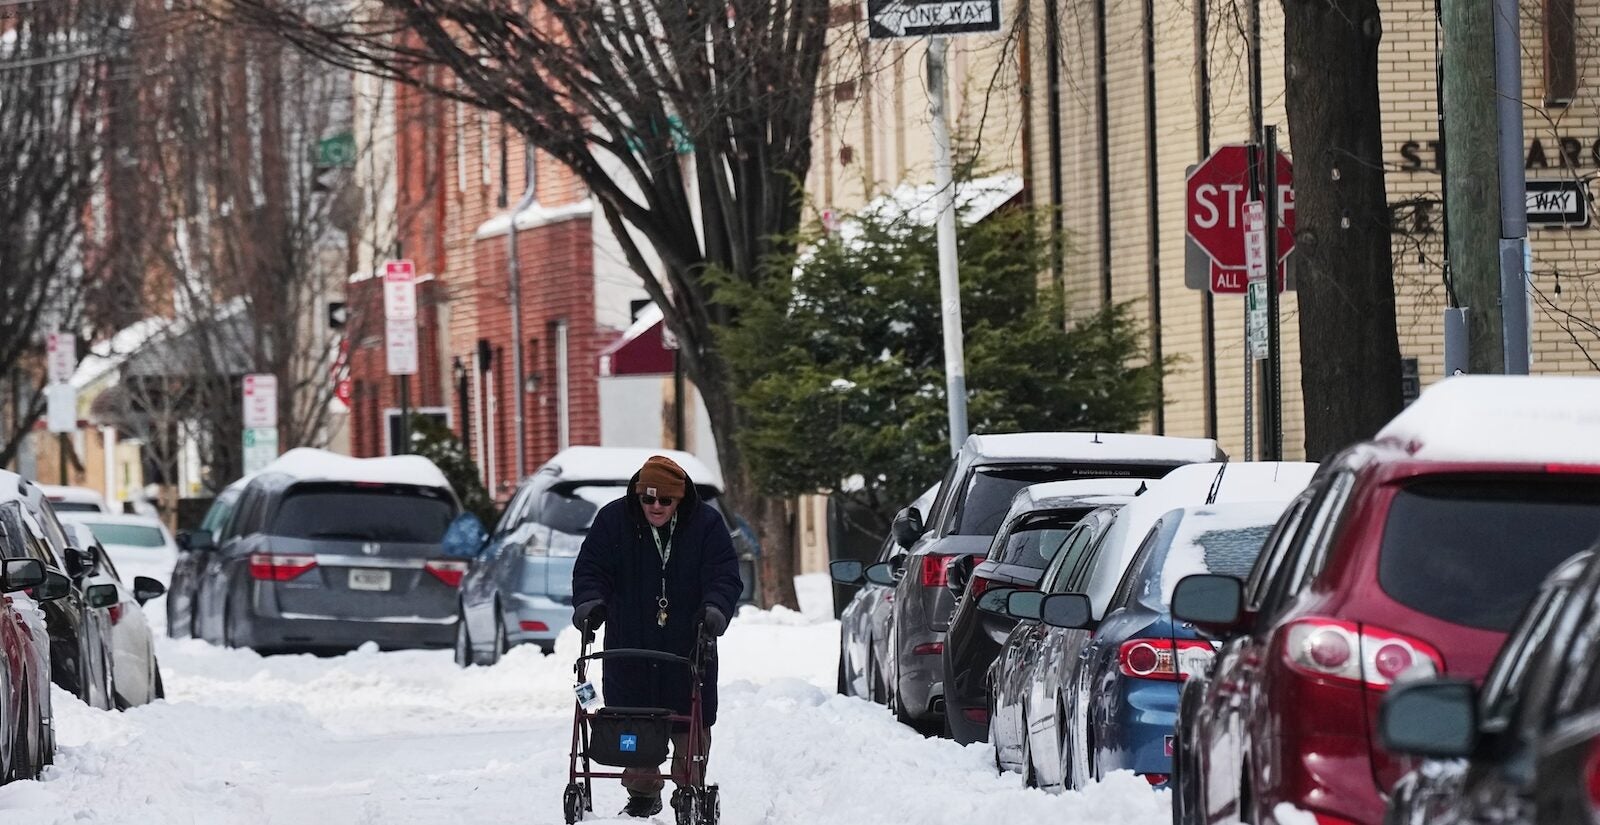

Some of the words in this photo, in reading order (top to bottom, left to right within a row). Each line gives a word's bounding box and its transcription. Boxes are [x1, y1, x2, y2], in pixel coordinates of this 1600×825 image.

[907, 6, 942, 24] ONE
[949, 3, 985, 21] WAY
[1194, 183, 1296, 229] STP
[1535, 193, 1571, 211] WAY
[1216, 273, 1241, 289] ALL
